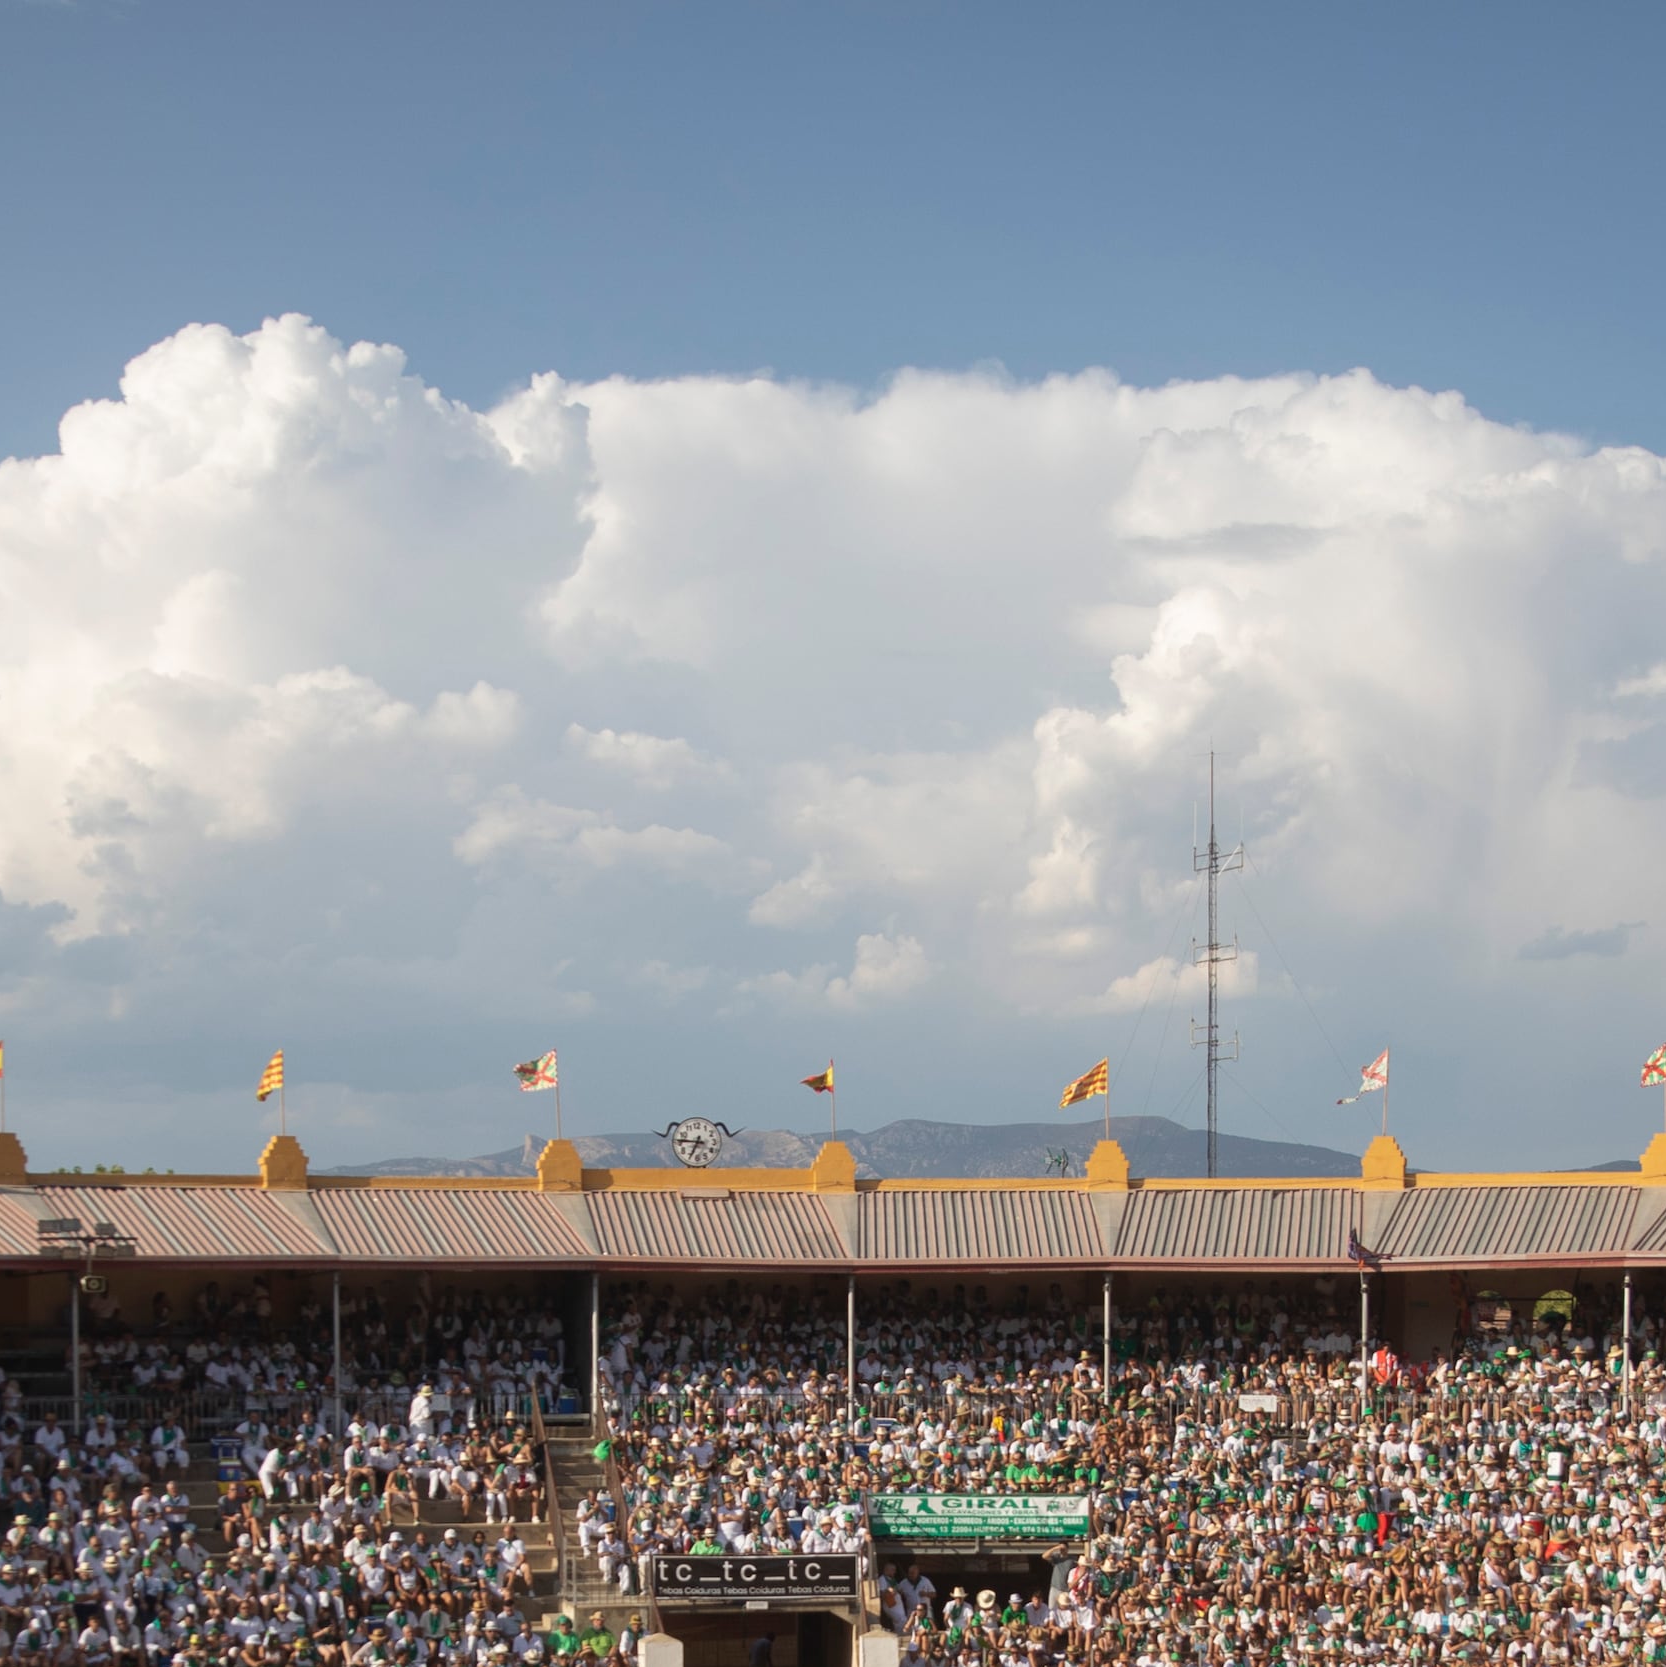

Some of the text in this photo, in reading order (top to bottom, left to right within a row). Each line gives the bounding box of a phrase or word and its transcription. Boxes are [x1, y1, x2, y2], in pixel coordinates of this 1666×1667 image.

[693, 1122, 701, 1130] 12
[711, 1138, 717, 1146] 3
[703, 1152, 708, 1160] 5
[941, 1498, 1039, 1508] GIRAL
[658, 1584, 850, 1595] Tebas Coiduras Tebas Coiduras Tebas Coiduras
